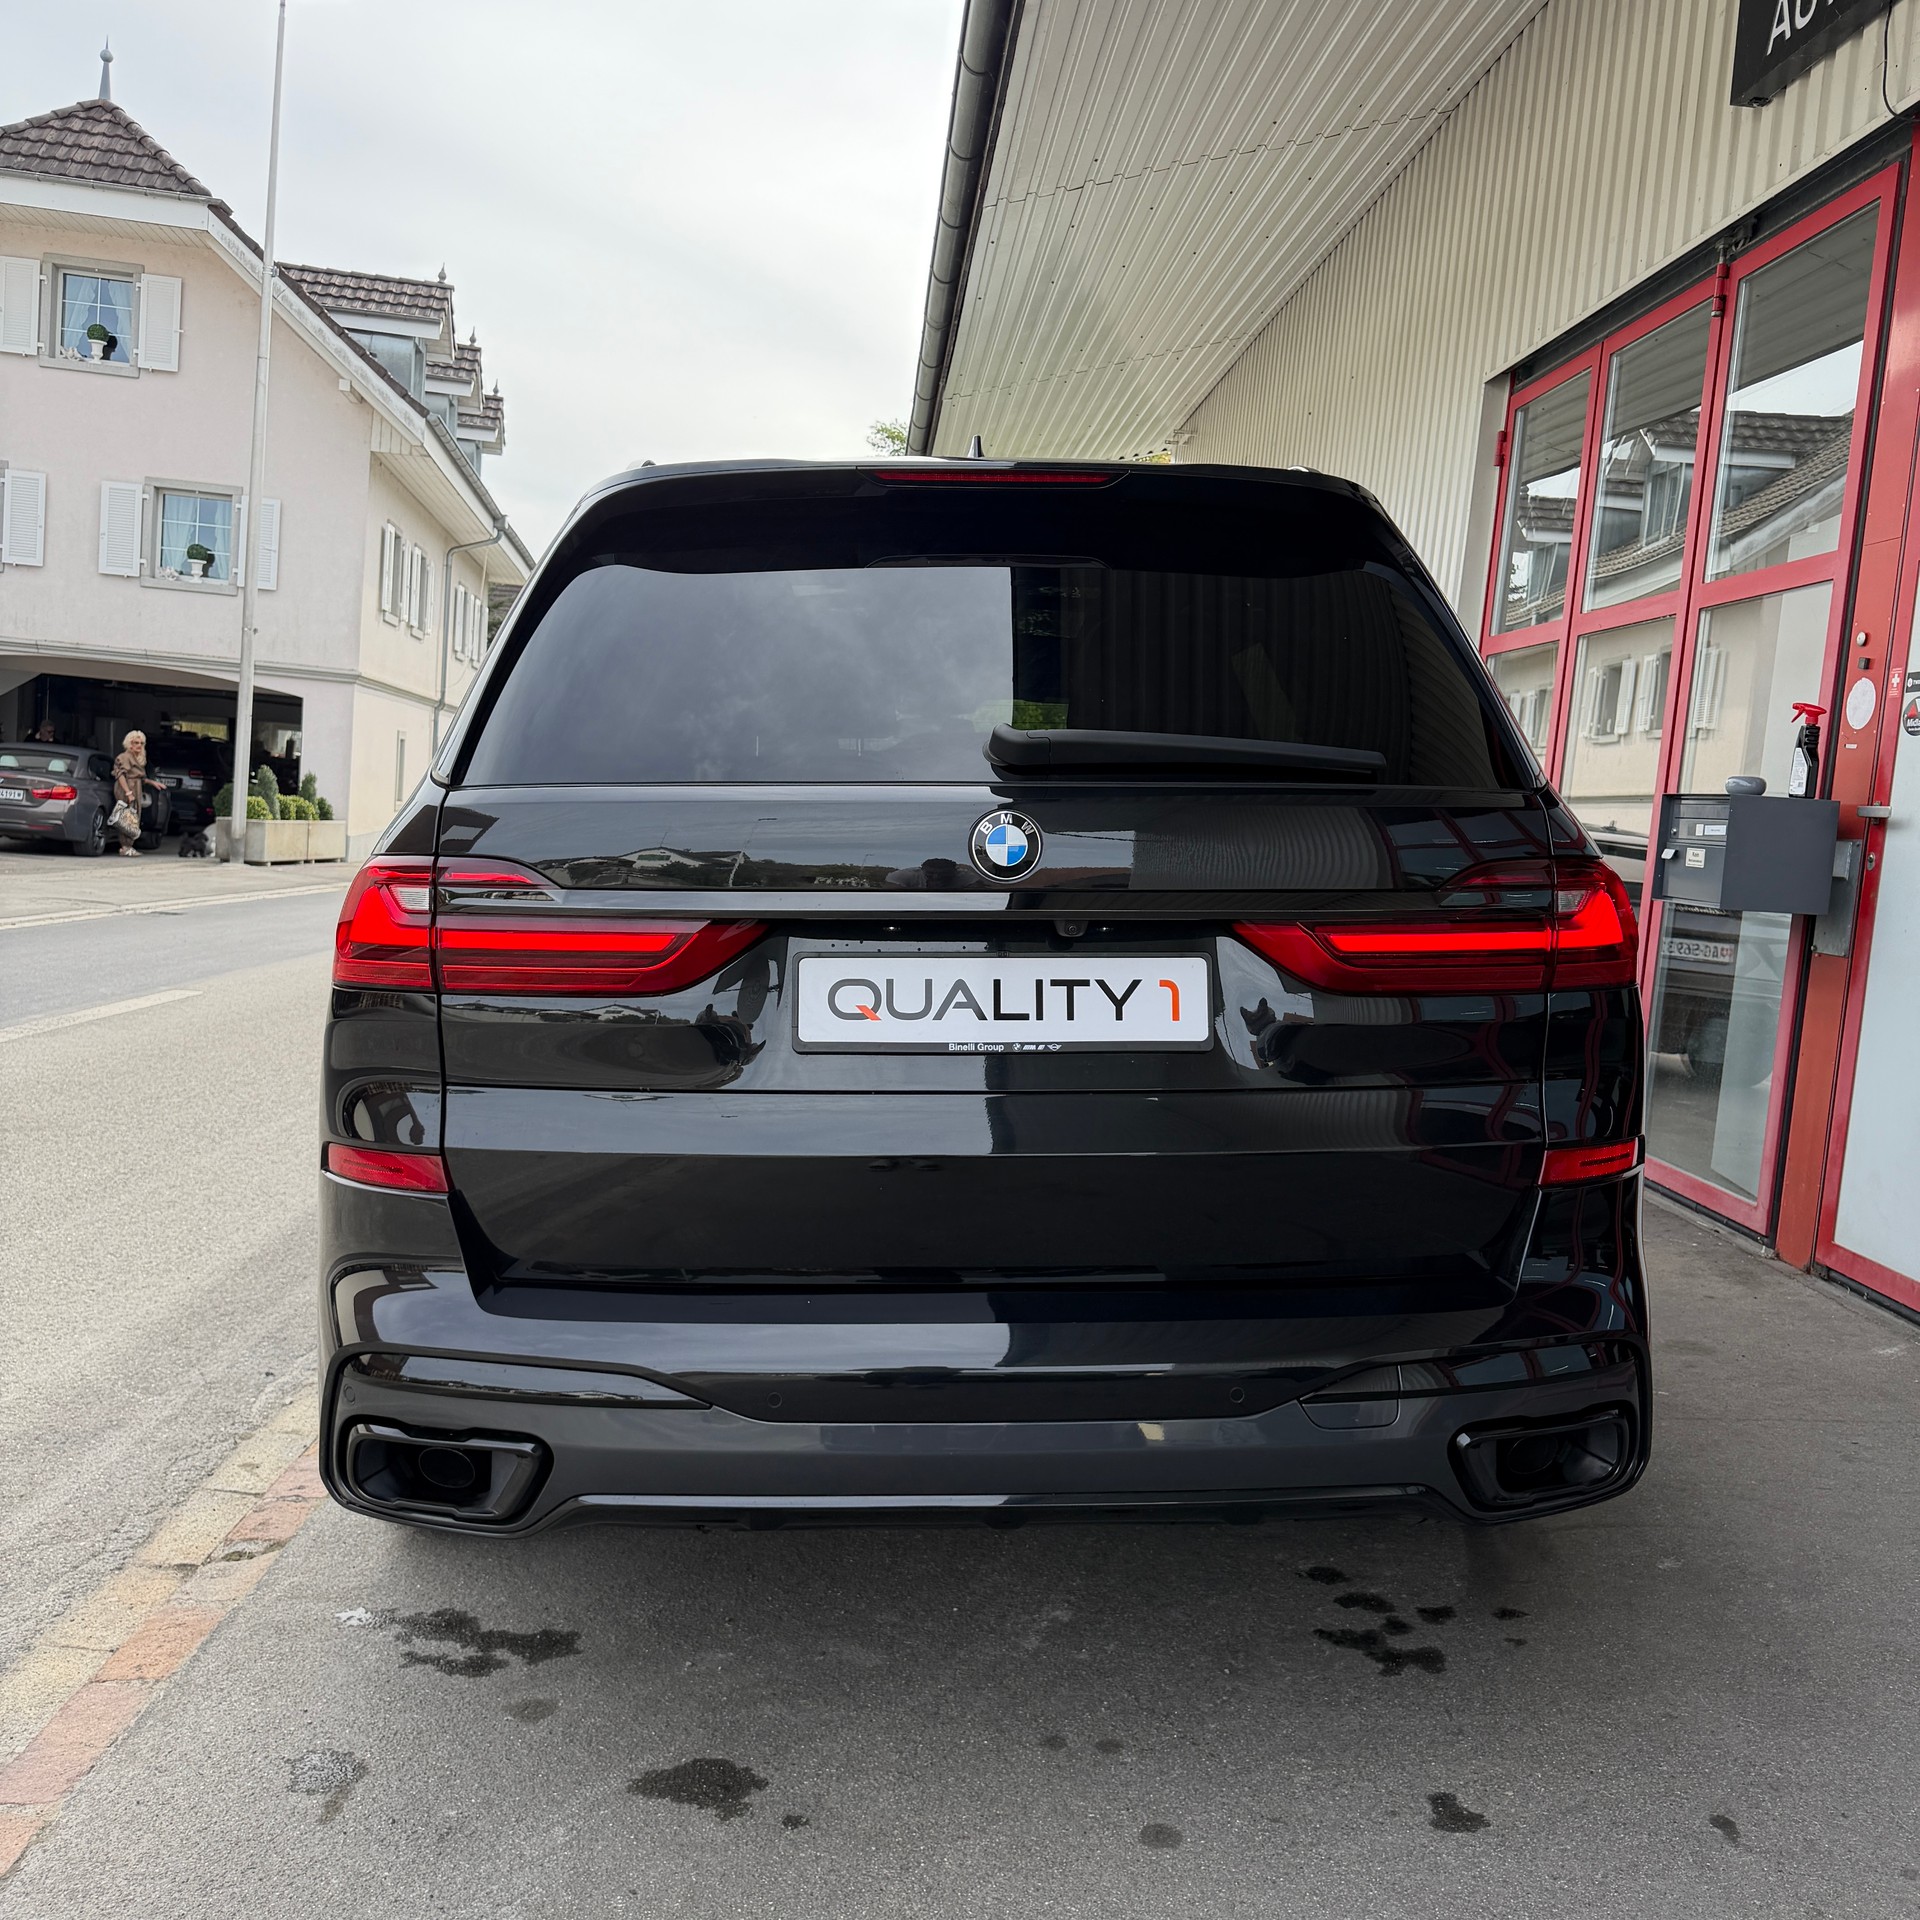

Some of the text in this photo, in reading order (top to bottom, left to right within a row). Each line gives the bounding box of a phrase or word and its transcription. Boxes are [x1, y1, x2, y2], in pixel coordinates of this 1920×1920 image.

[979, 813, 1035, 835] BMW
[827, 978, 1181, 1022] QUALITY 1
[948, 1043, 1005, 1053] Binelli Group
